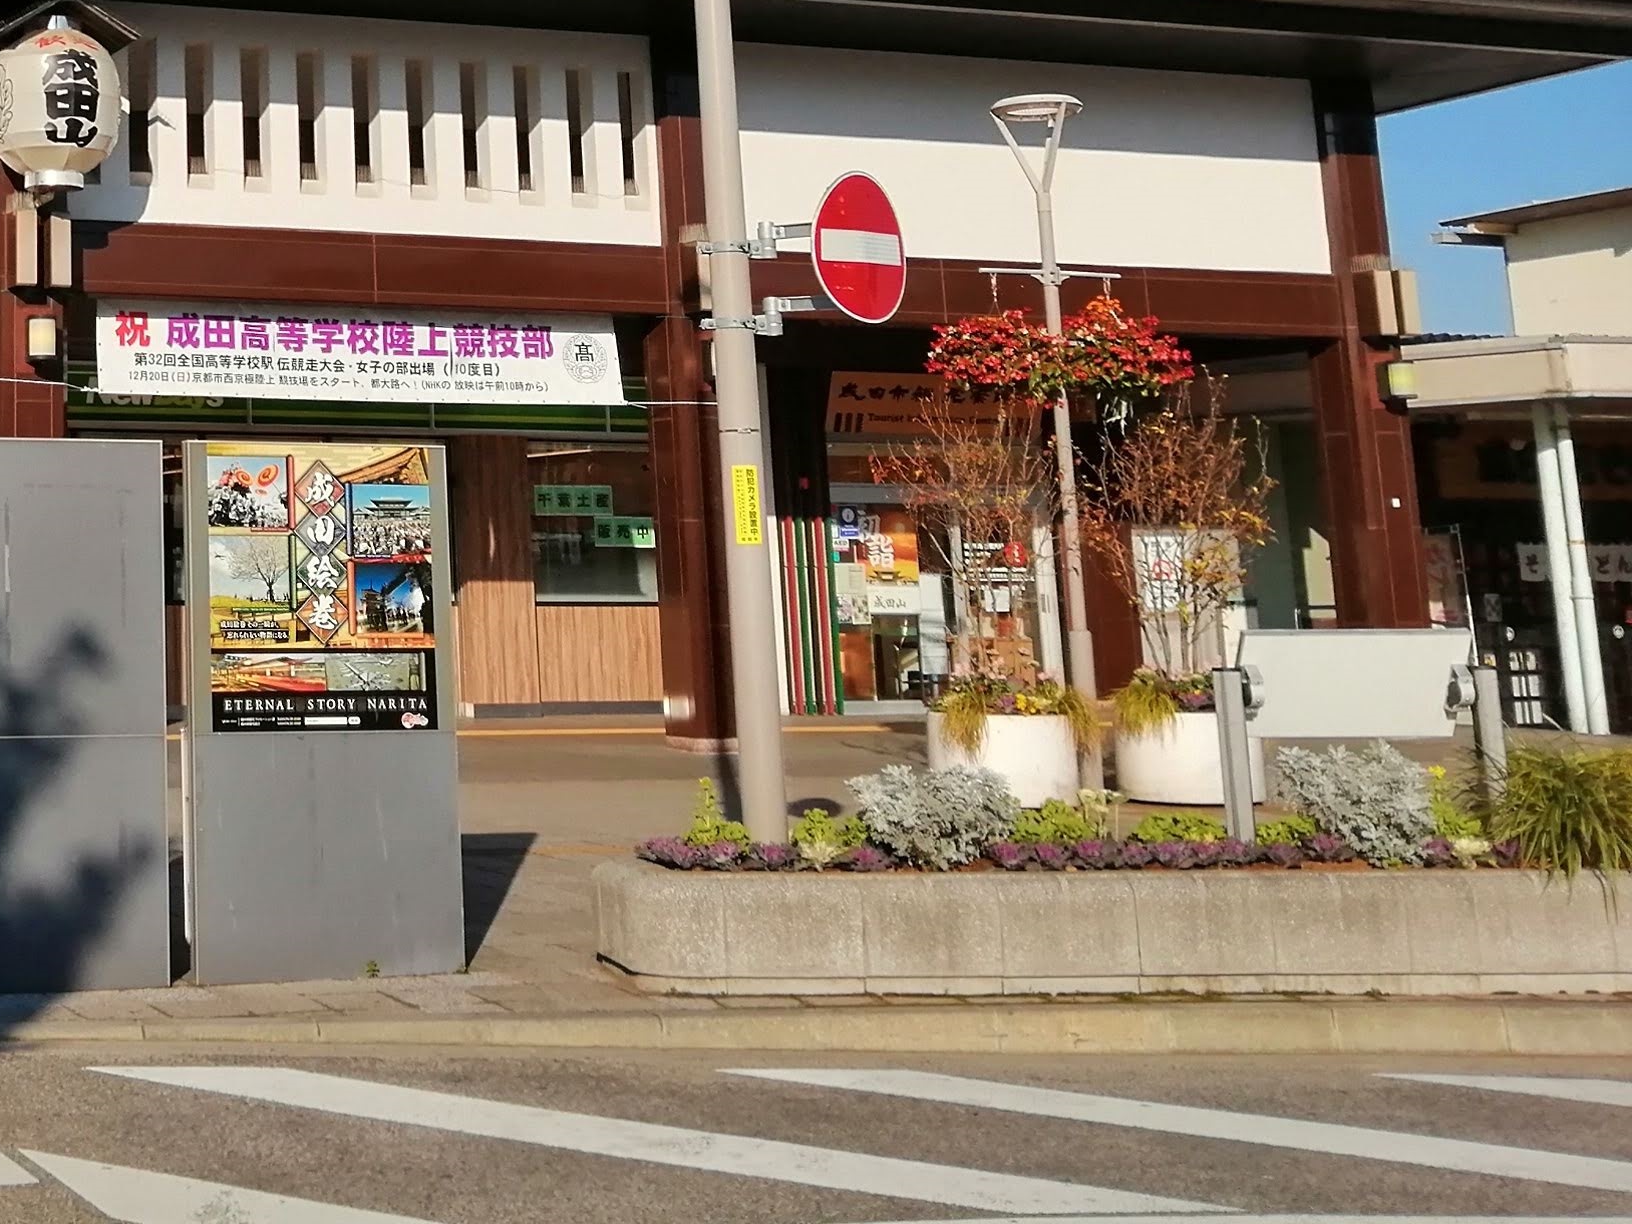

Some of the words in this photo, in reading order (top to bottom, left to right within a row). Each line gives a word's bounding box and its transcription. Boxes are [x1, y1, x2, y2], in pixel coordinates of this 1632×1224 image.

[42, 48, 100, 148] 成田山
[115, 310, 151, 347] 祝
[166, 313, 554, 360] 成田高等学校陸上競技部
[305, 471, 340, 630] 成田絵巻
[224, 699, 295, 712] ETERNAL
[307, 698, 356, 711] STORY
[367, 697, 427, 710] NARITA
